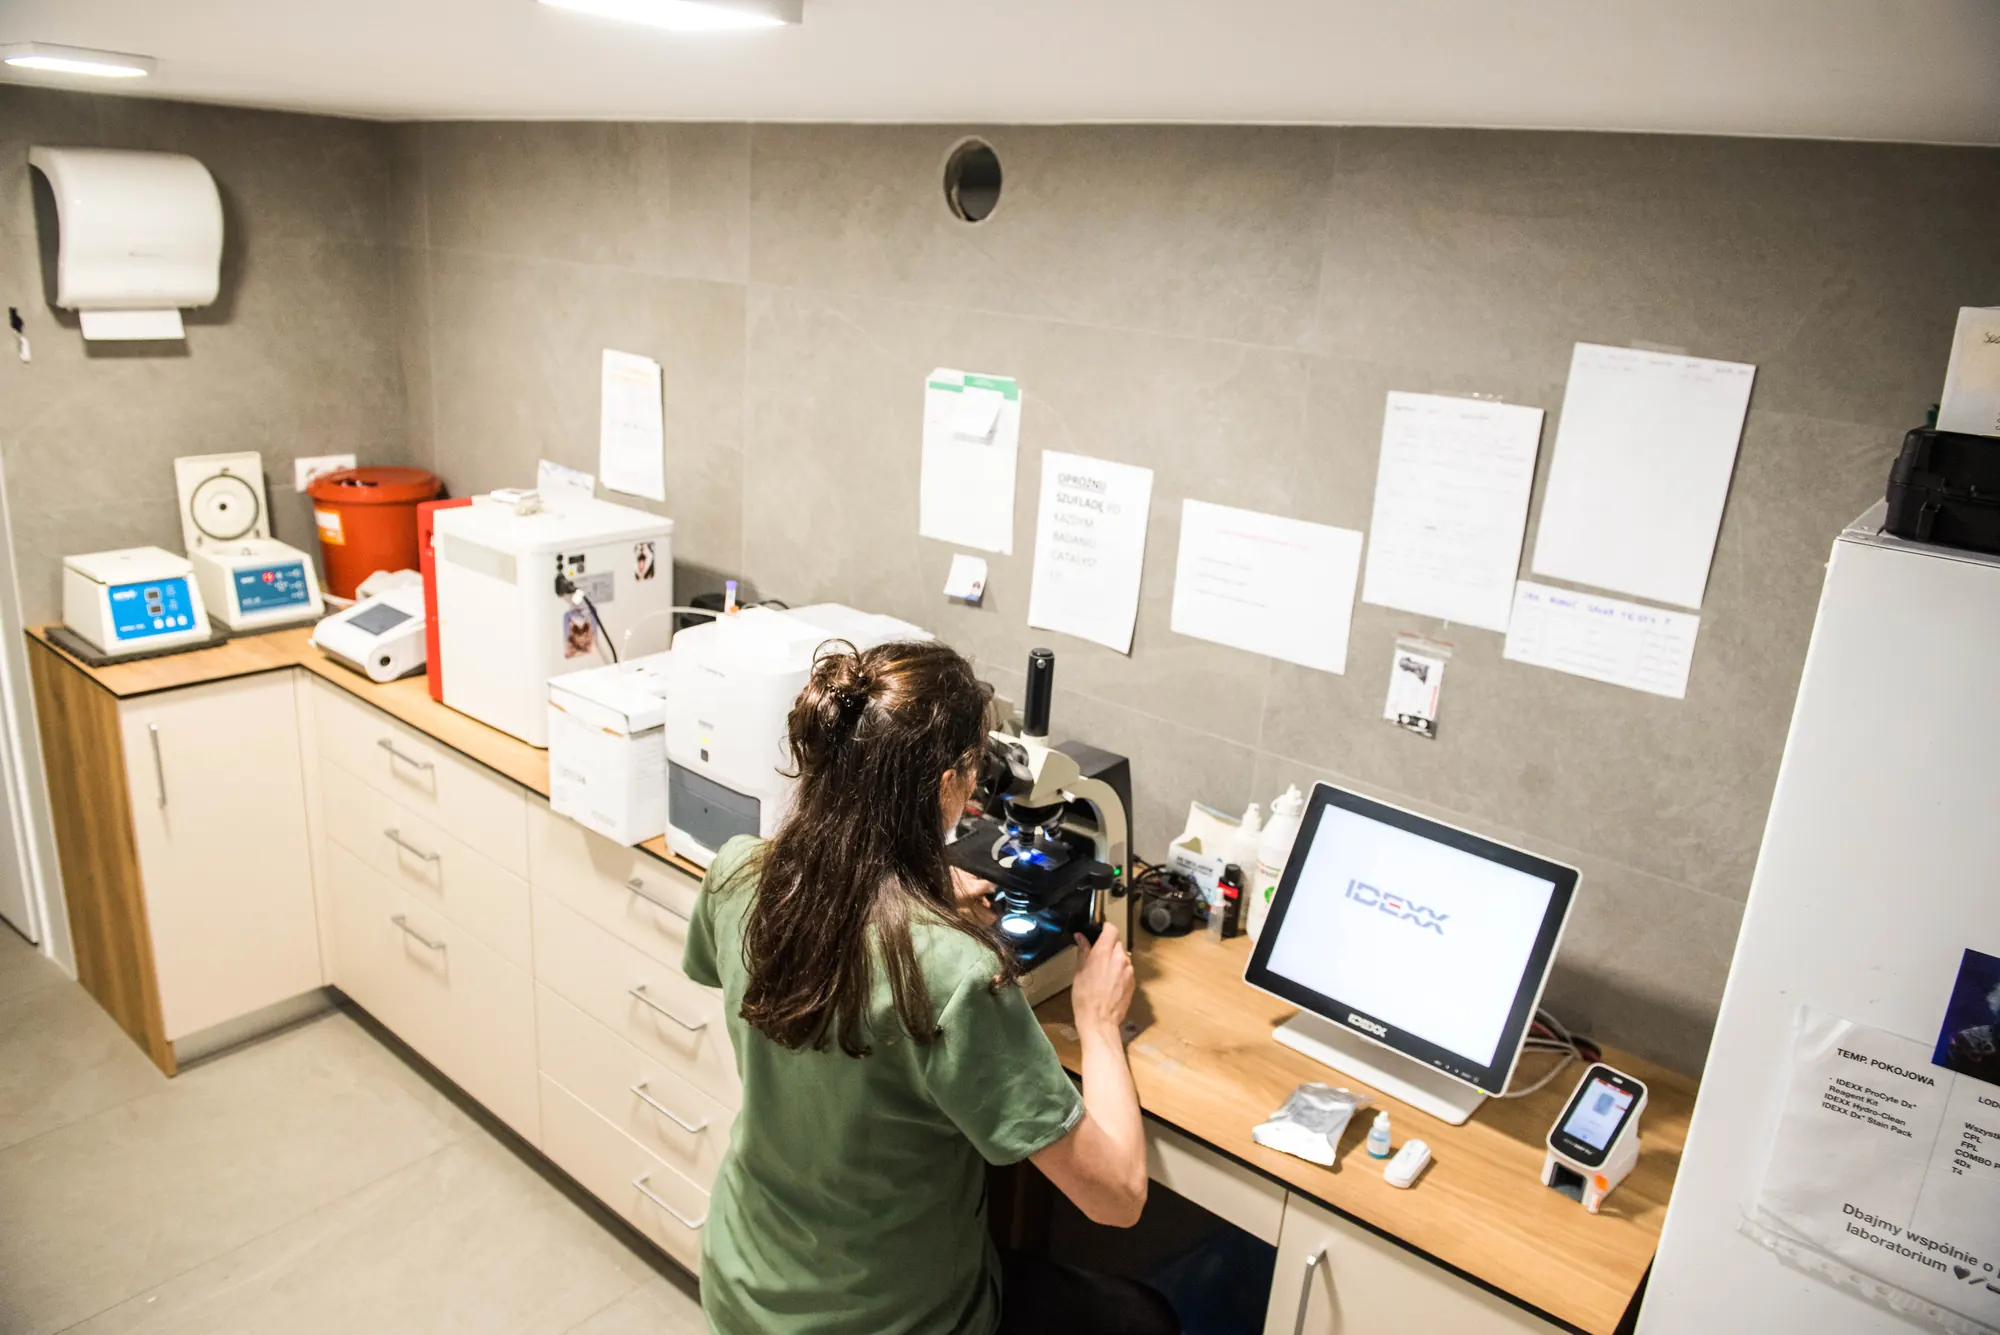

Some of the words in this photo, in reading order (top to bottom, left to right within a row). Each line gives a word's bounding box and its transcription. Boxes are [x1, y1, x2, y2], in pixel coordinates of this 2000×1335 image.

[1345, 879, 1450, 935] IDEXX
[1348, 1013, 1387, 1038] IDEXX
[1837, 1048, 1868, 1064] TEMP.
[1870, 1059, 1935, 1086] POKOJOWA
[1829, 1085, 1865, 1102] Reagent
[1866, 1097, 1879, 1107] Kit
[1836, 1078, 1863, 1092] IDEXX
[1864, 1087, 1899, 1104] ProCyte
[1978, 1096, 2000, 1109] LOD
[1822, 1101, 1849, 1115] IDEXX
[1867, 1116, 1889, 1129] Stain
[1890, 1125, 1913, 1138] Pack
[1824, 1092, 1851, 1107] IDEXX
[1852, 1102, 1906, 1126] Hydro-Clean
[1960, 1140, 1978, 1152] FPL
[1963, 1132, 1982, 1143] CPL
[1954, 1148, 1992, 1167] COMBO
[1954, 1158, 1971, 1169] 4Dx
[1952, 1166, 1963, 1175] T4
[1842, 1203, 1902, 1236] Dbajmy
[1906, 1230, 1978, 1266] wspólnie
[1982, 1262, 1994, 1272] o
[1846, 1222, 1948, 1272] laboratorium
